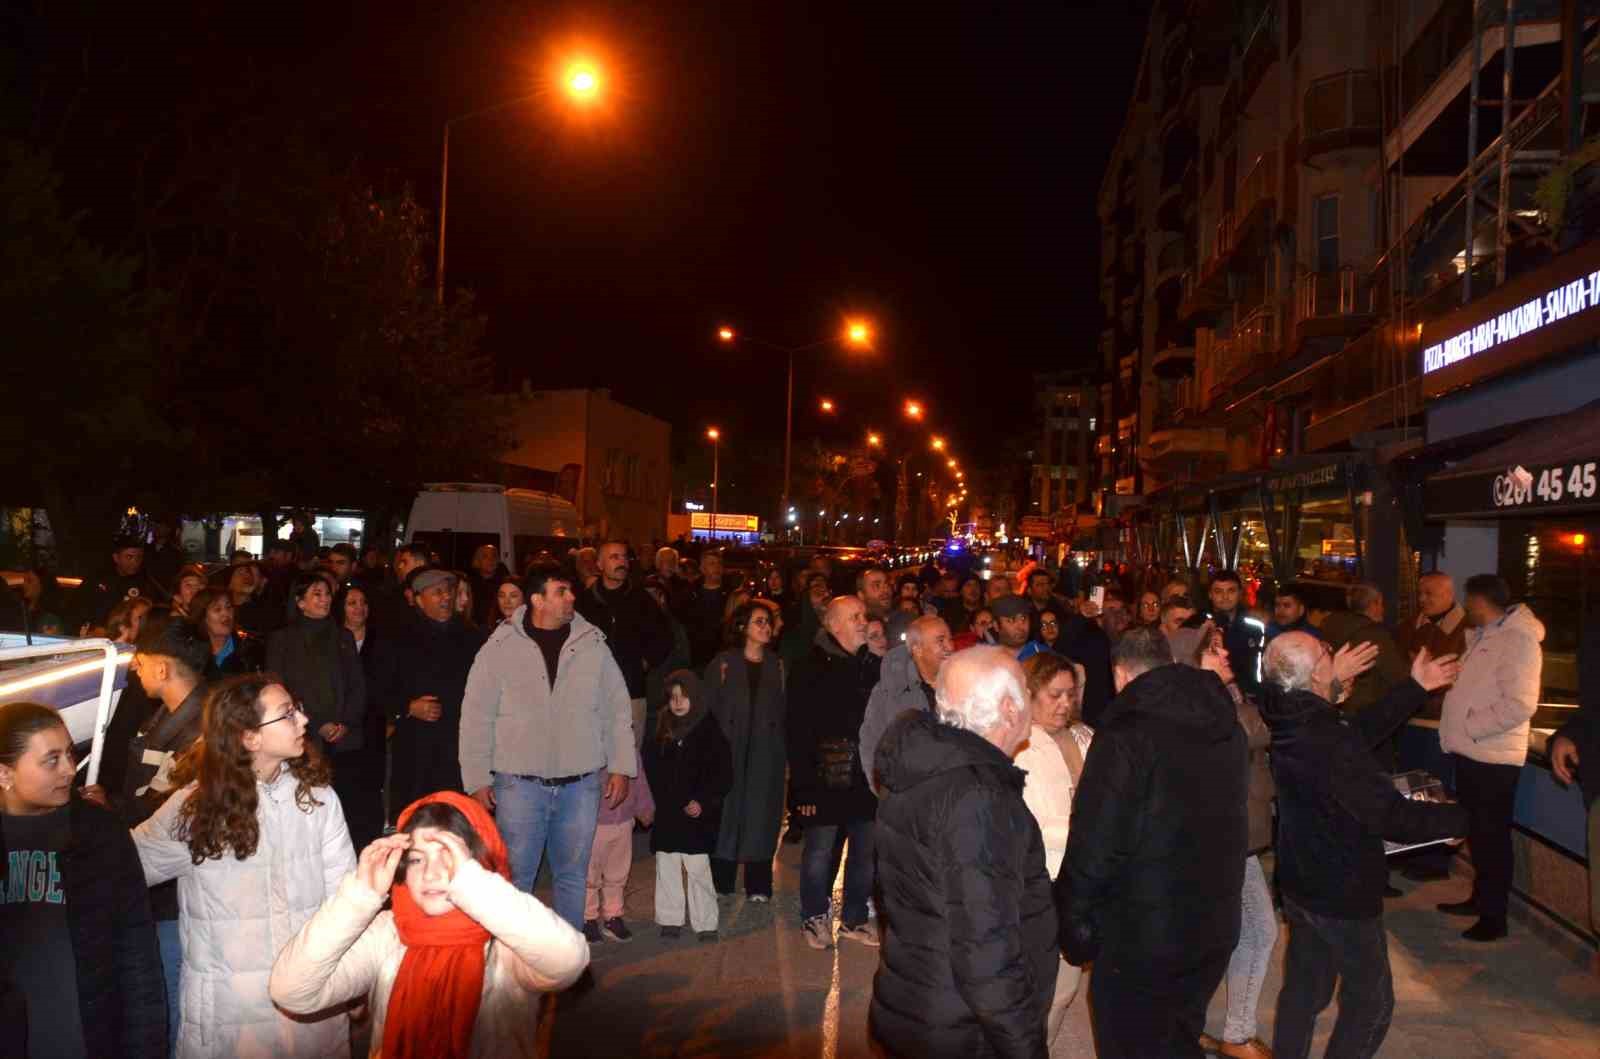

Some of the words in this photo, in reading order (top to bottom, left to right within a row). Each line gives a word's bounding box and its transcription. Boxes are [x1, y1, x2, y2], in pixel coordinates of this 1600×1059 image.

[1537, 467, 1563, 501] 45
[1567, 462, 1597, 498] 45
[0, 849, 66, 905] NGE
